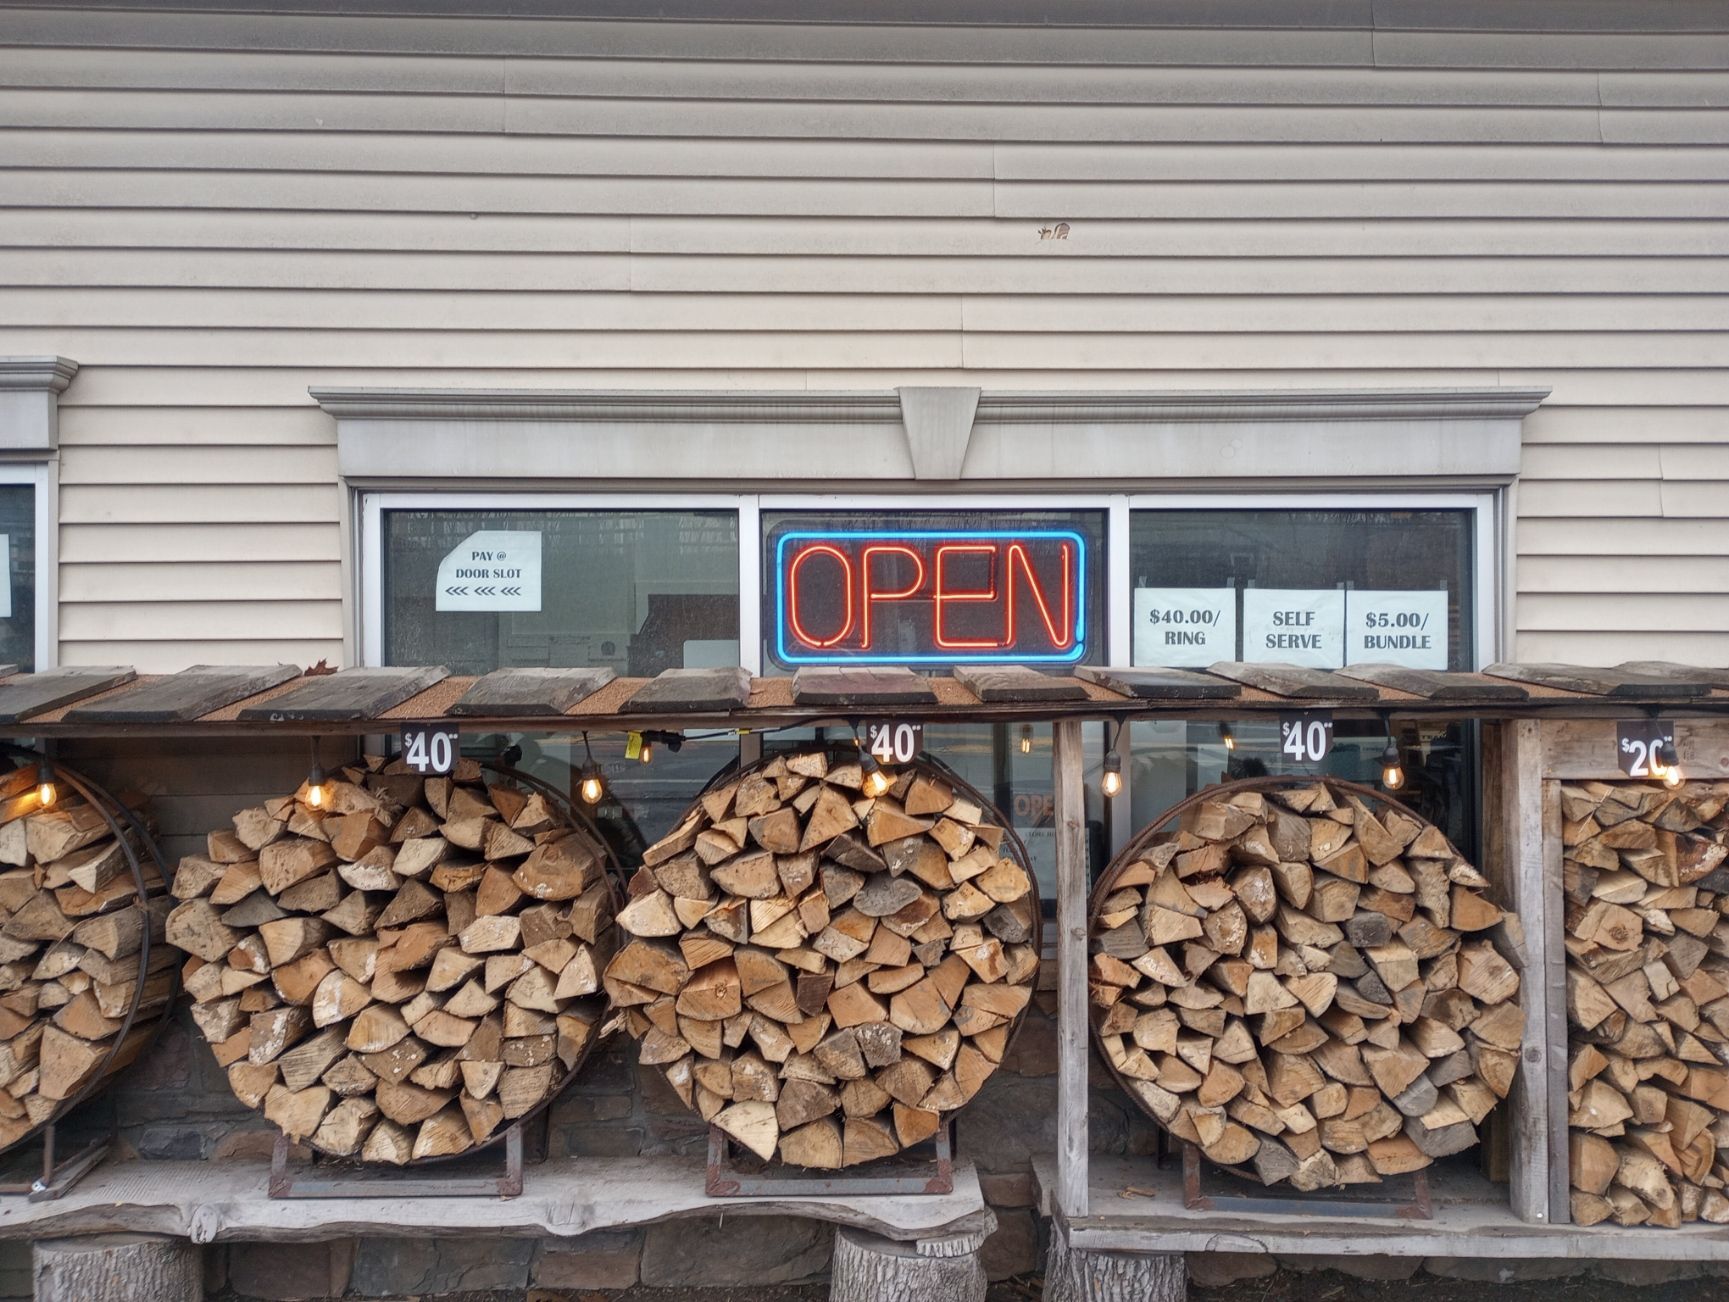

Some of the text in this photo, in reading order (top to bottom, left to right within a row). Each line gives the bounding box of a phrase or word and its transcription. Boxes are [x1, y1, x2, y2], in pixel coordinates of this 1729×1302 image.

[471, 551, 507, 561] PAY @
[455, 568, 522, 579] DOOR SLOT
[788, 541, 1072, 650] OPEN
[1149, 608, 1221, 628] $40.00/
[1272, 610, 1316, 627] SELF
[1365, 611, 1430, 632] $5.00/
[1165, 631, 1206, 646] RING
[1265, 633, 1323, 649] SERVE
[1364, 635, 1432, 649] BUNDLE
